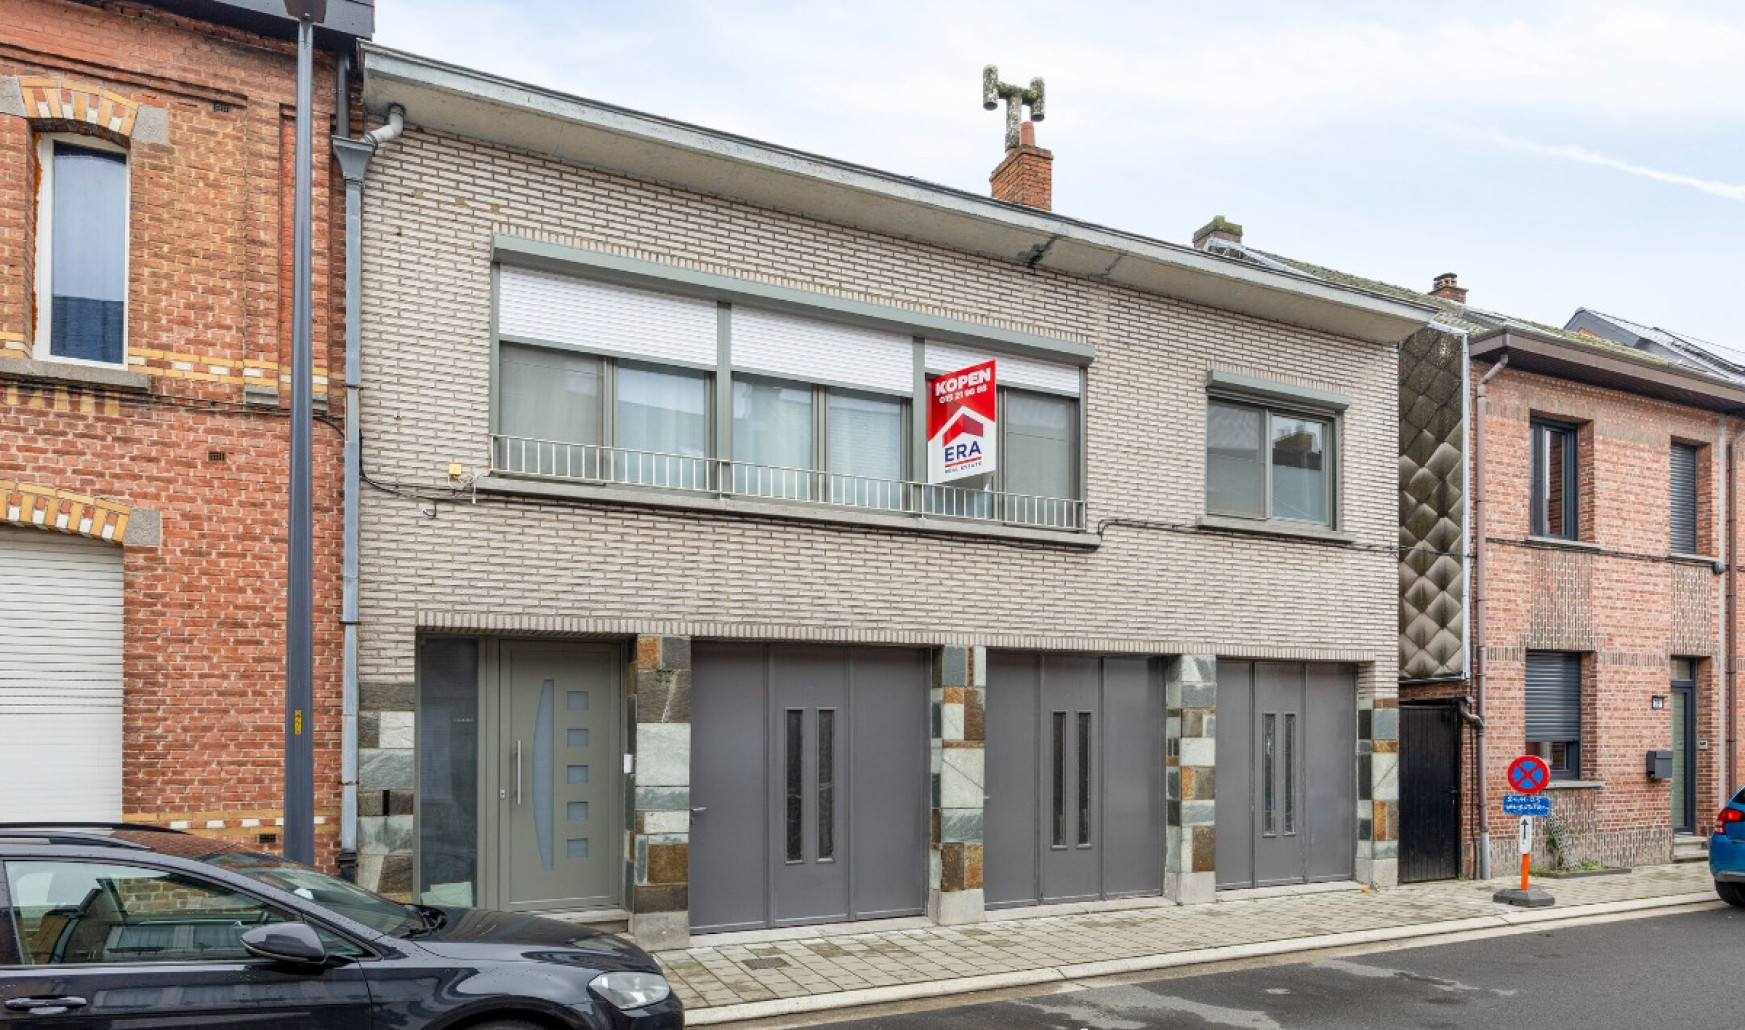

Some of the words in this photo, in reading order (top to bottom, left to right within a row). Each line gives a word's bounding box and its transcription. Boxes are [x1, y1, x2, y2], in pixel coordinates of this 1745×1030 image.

[935, 367, 991, 397] KOPEN
[944, 440, 982, 462] ERA
[960, 461, 982, 471] ESTATE
